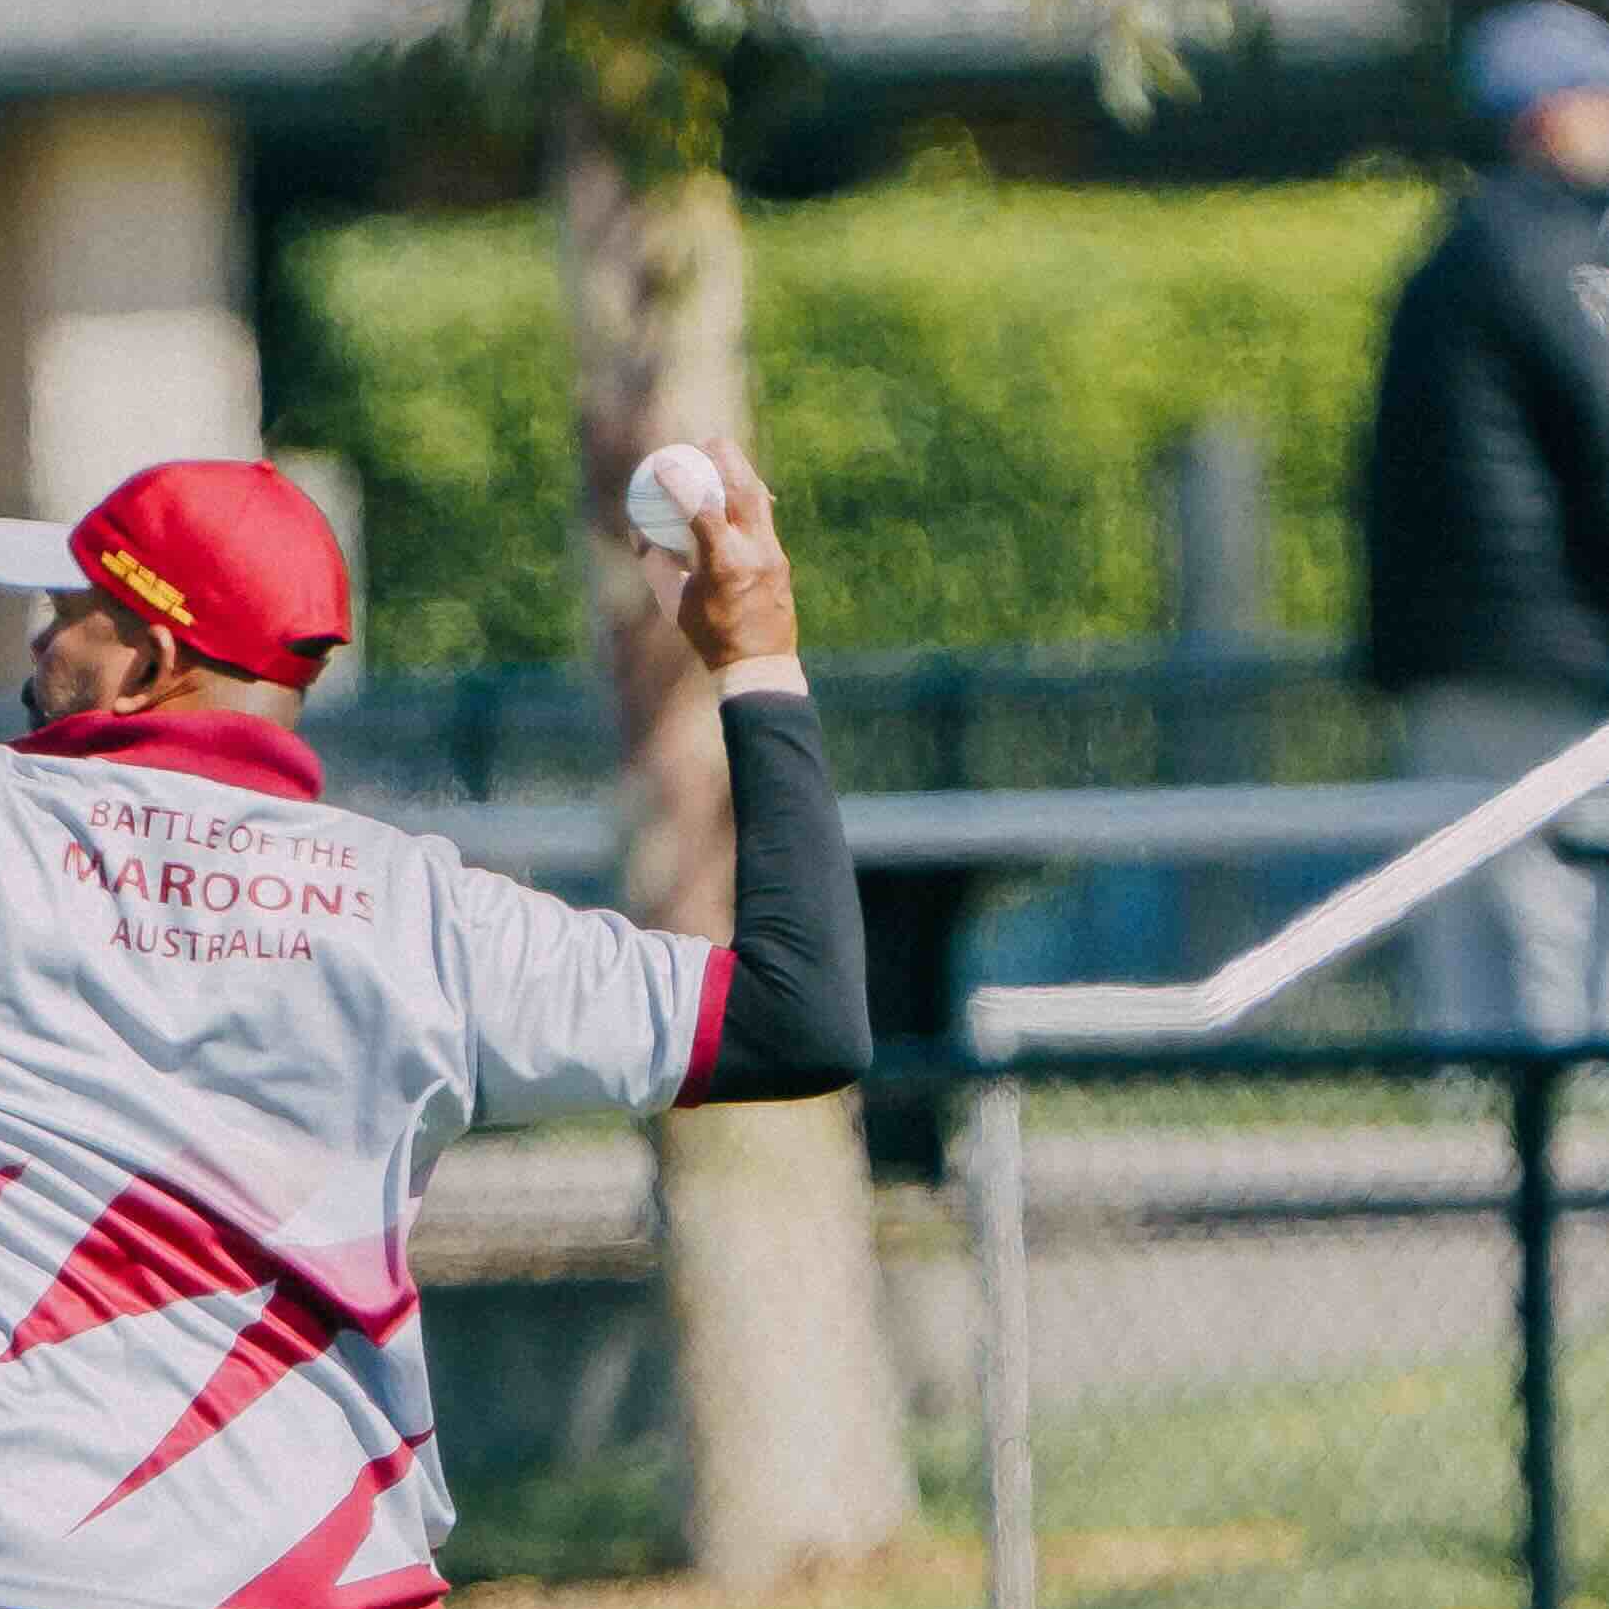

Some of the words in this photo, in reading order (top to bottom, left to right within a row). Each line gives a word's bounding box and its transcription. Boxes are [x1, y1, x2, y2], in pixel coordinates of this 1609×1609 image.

[286, 836, 359, 871] THE
[63, 841, 375, 925] MAROONS
[110, 917, 313, 962] AUSTRALIA
